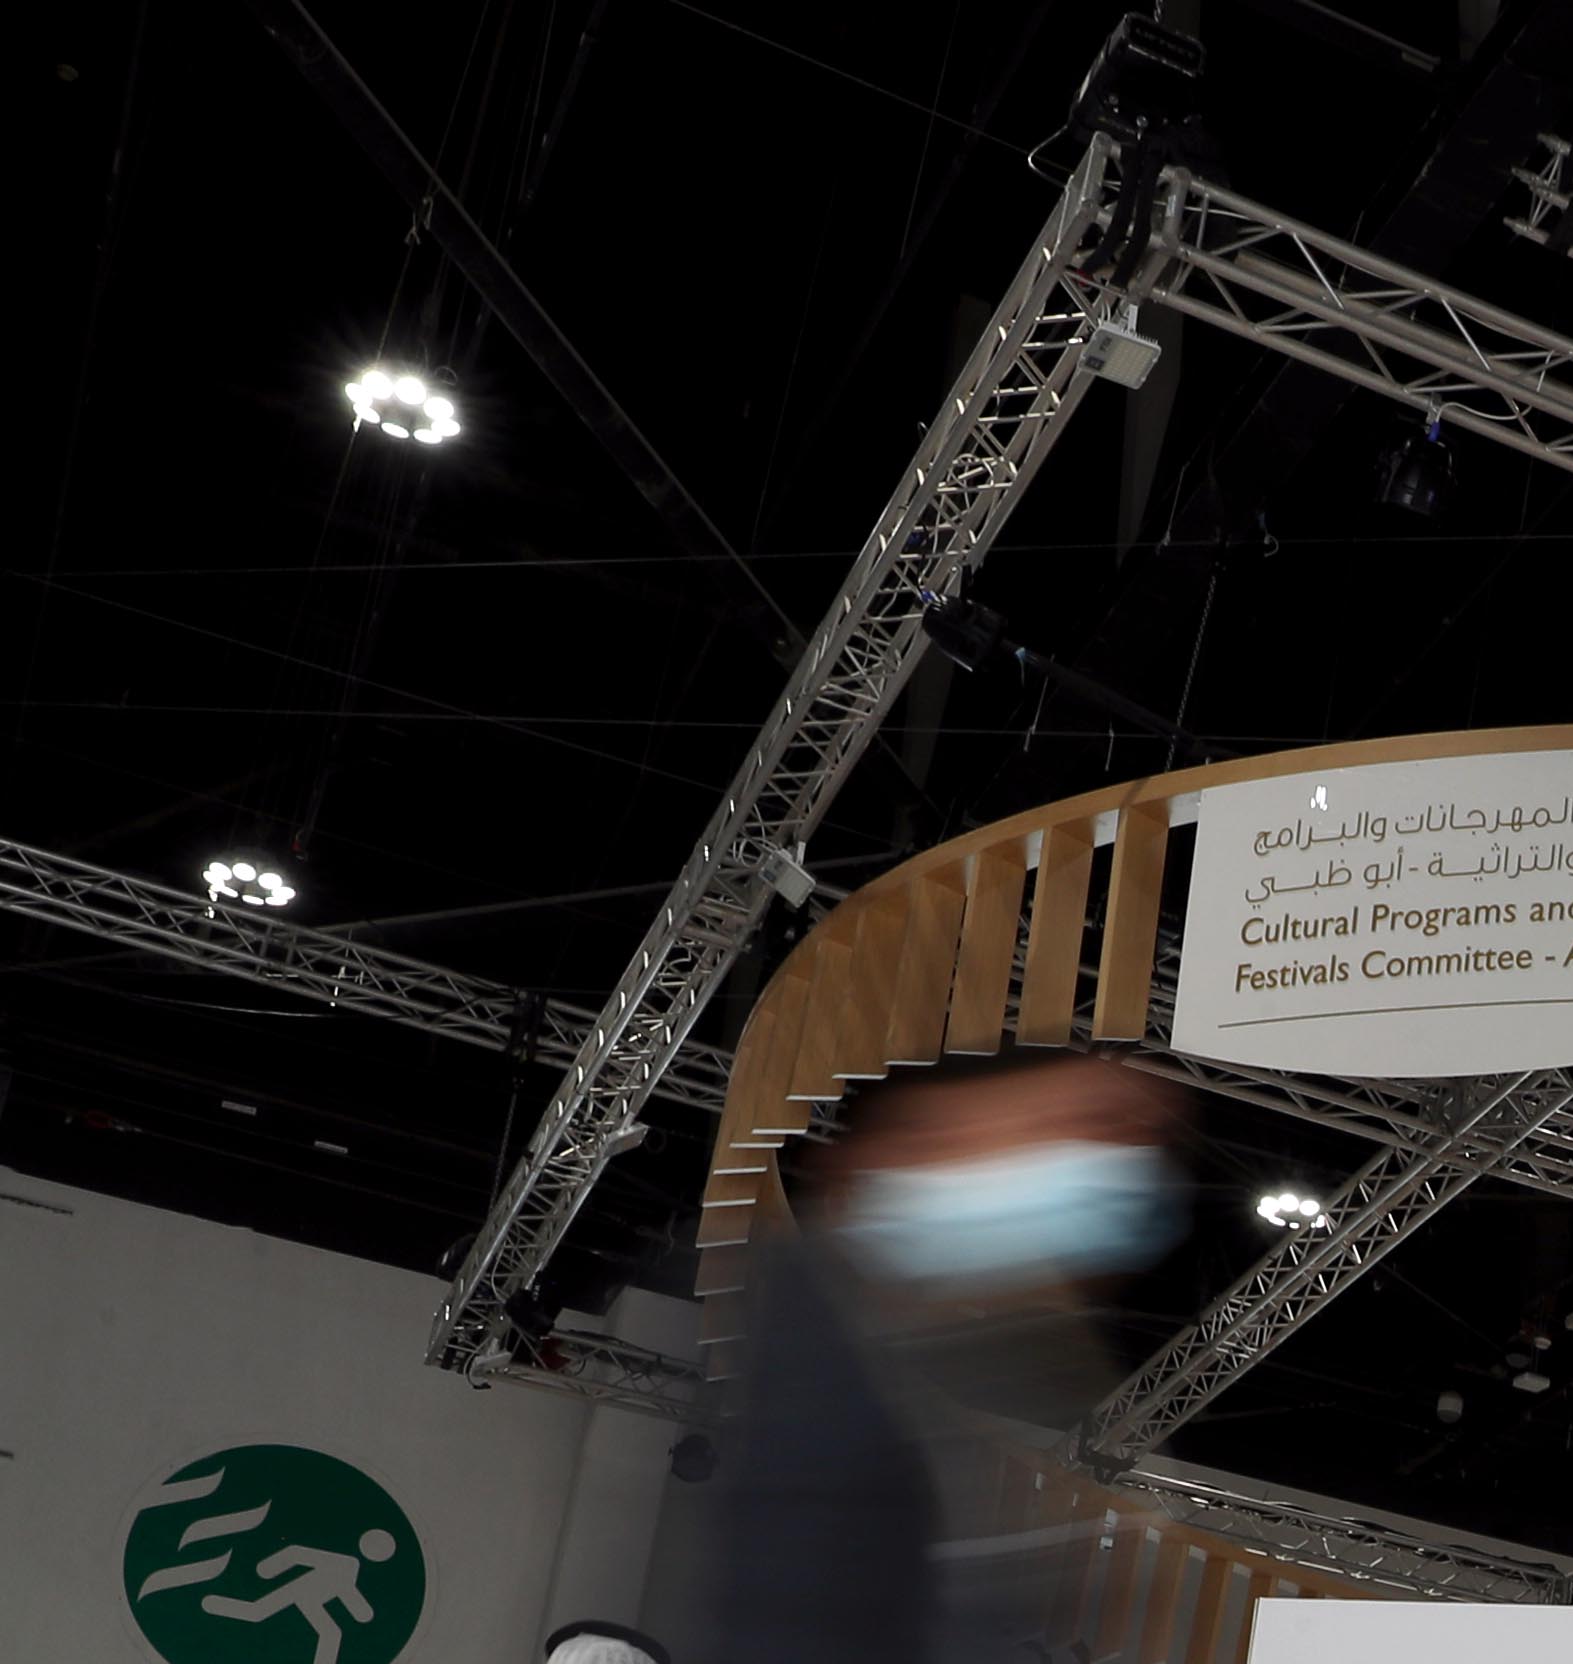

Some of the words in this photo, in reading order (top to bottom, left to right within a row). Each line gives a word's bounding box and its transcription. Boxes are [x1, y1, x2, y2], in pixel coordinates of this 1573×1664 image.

[1254, 810, 1387, 856] والبرامج
[1245, 858, 1353, 910] ظبي
[1363, 846, 1403, 890] أبو
[1241, 905, 1358, 946] Cultural
[1371, 902, 1516, 937] Programs
[1235, 954, 1349, 992] Festivals
[1361, 946, 1532, 979] Committee
